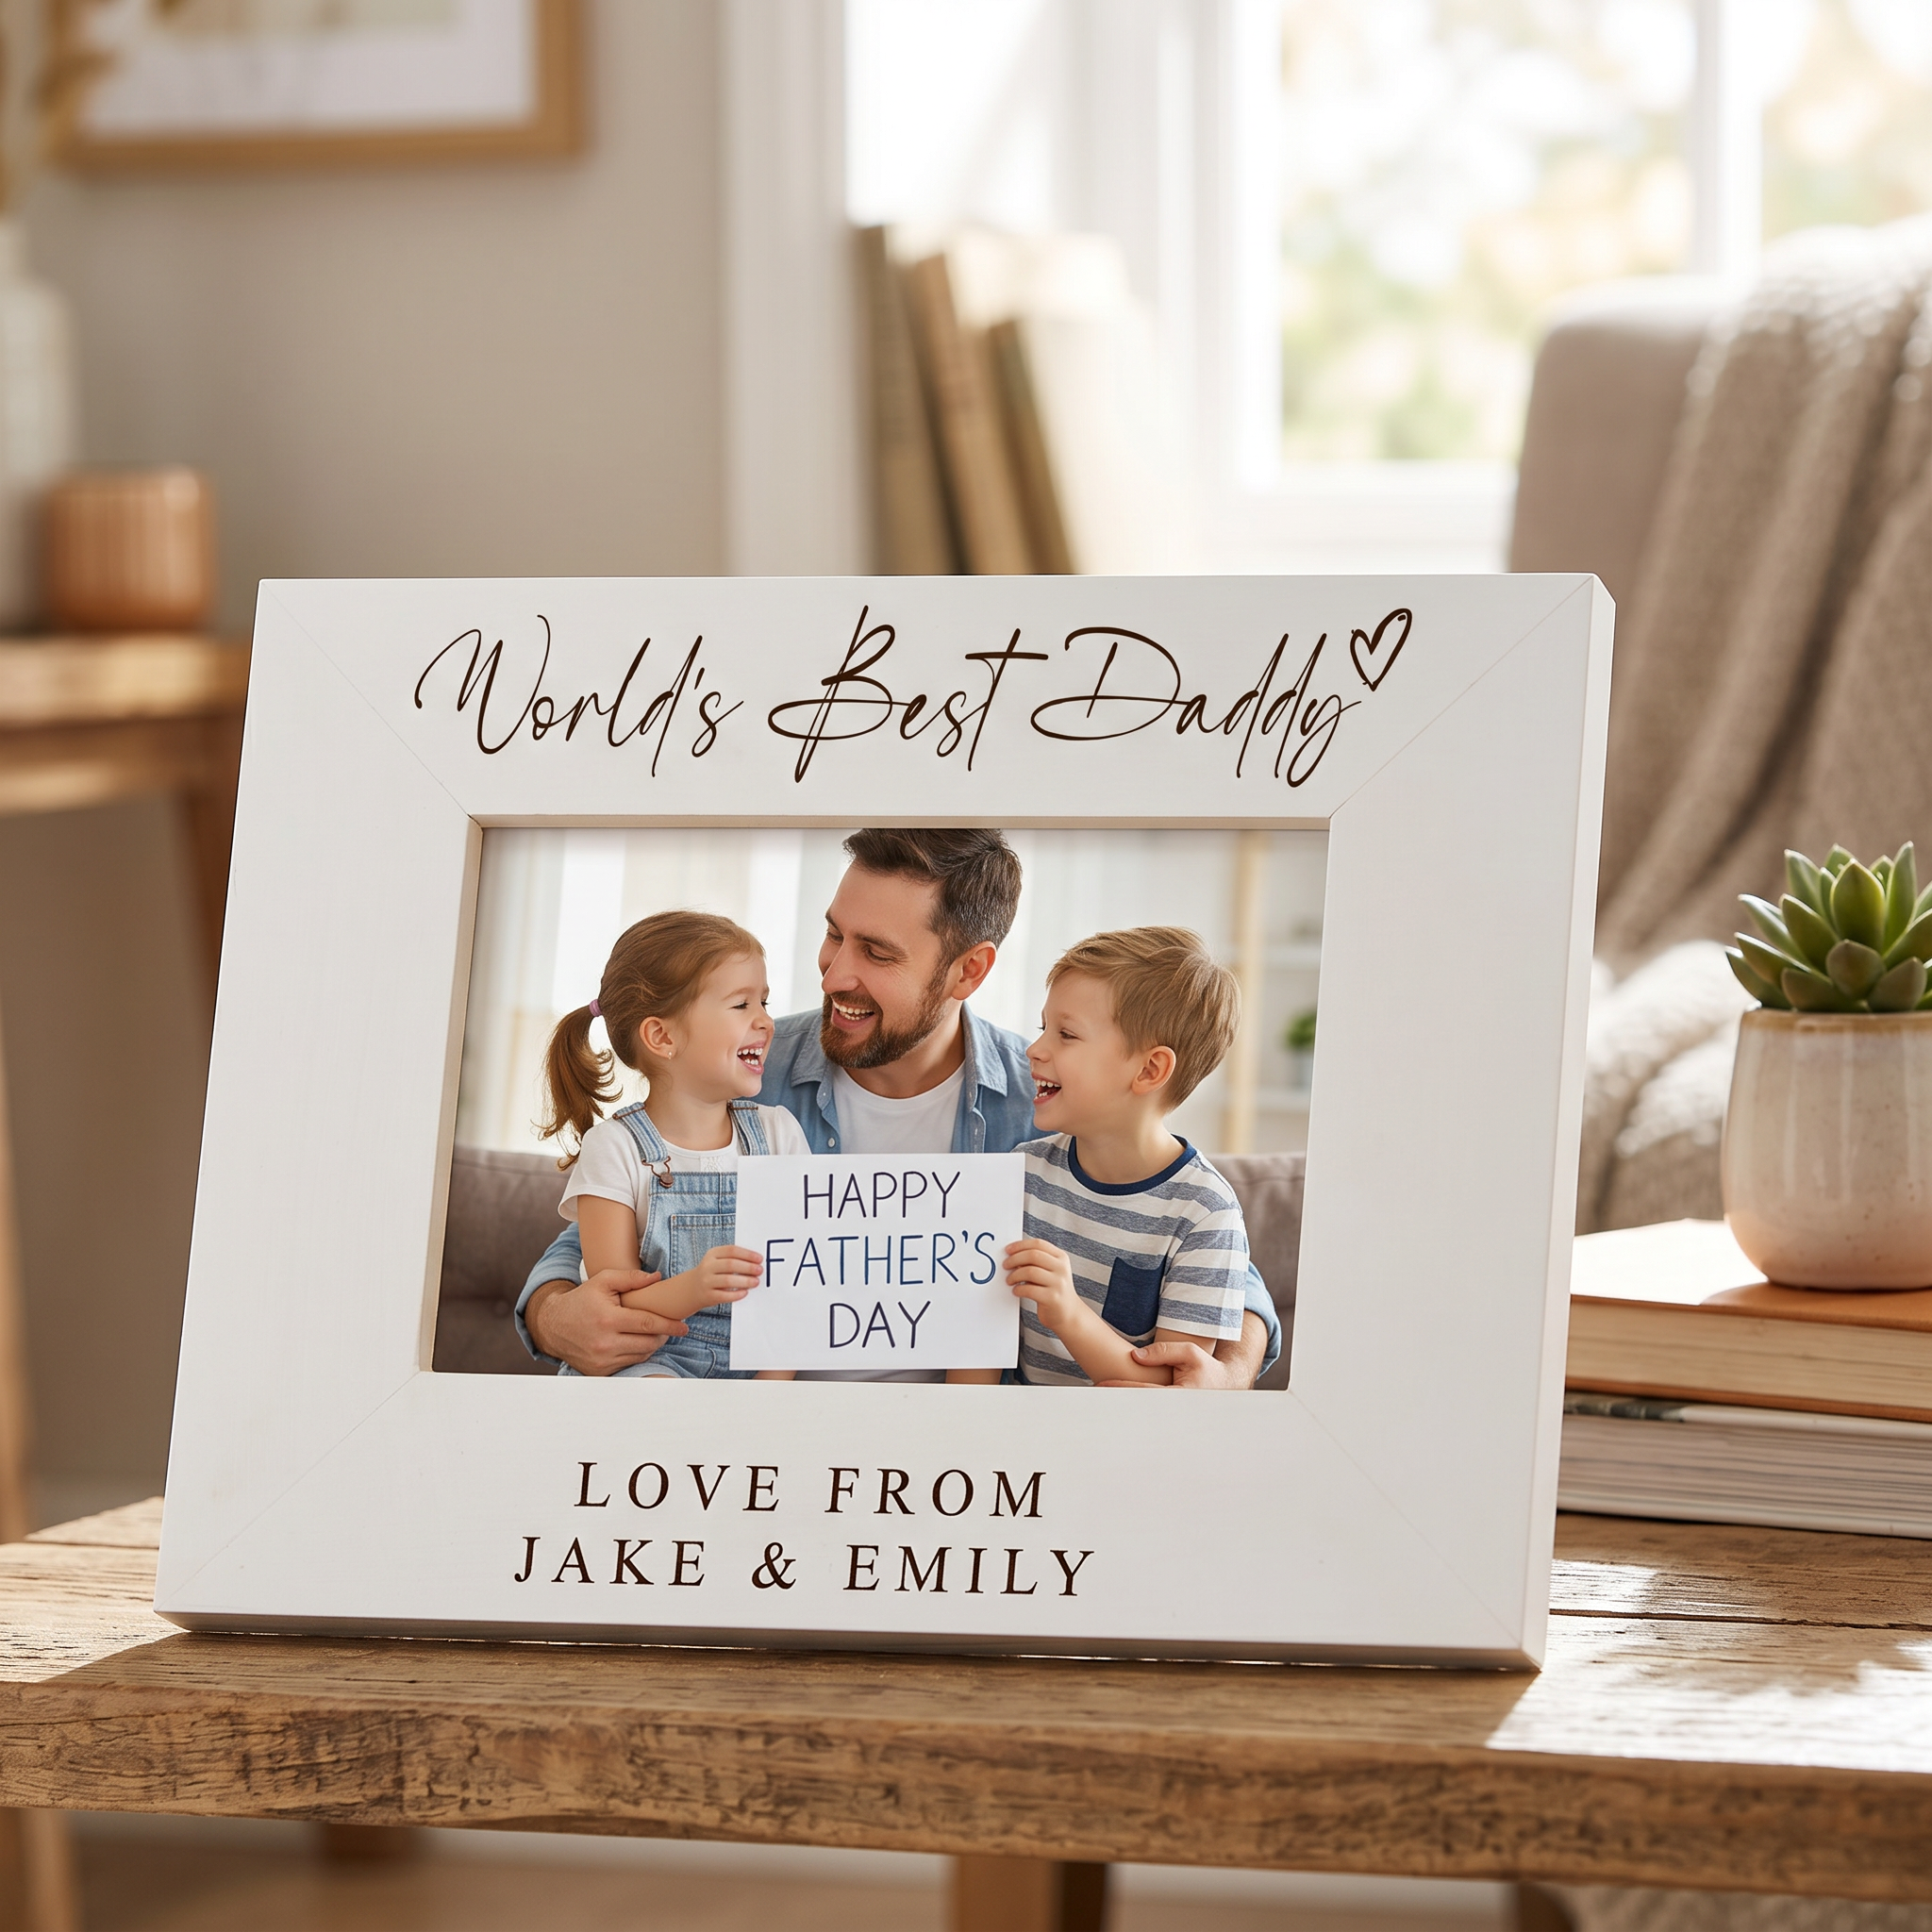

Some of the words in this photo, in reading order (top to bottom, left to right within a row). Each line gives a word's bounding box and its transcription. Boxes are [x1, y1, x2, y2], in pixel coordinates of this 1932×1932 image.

[413, 614, 745, 778] World's
[767, 605, 1049, 784] Best
[1029, 626, 1362, 789] Daddy
[803, 1171, 961, 1220] HAPPY
[765, 1229, 997, 1288] FATHER'S
[829, 1300, 931, 1349] DAY
[574, 1461, 779, 1512] LOVE
[824, 1467, 1047, 1518] FROM
[513, 1536, 706, 1587] JAKE
[751, 1541, 797, 1591] &
[842, 1544, 1095, 1597] EMILY
